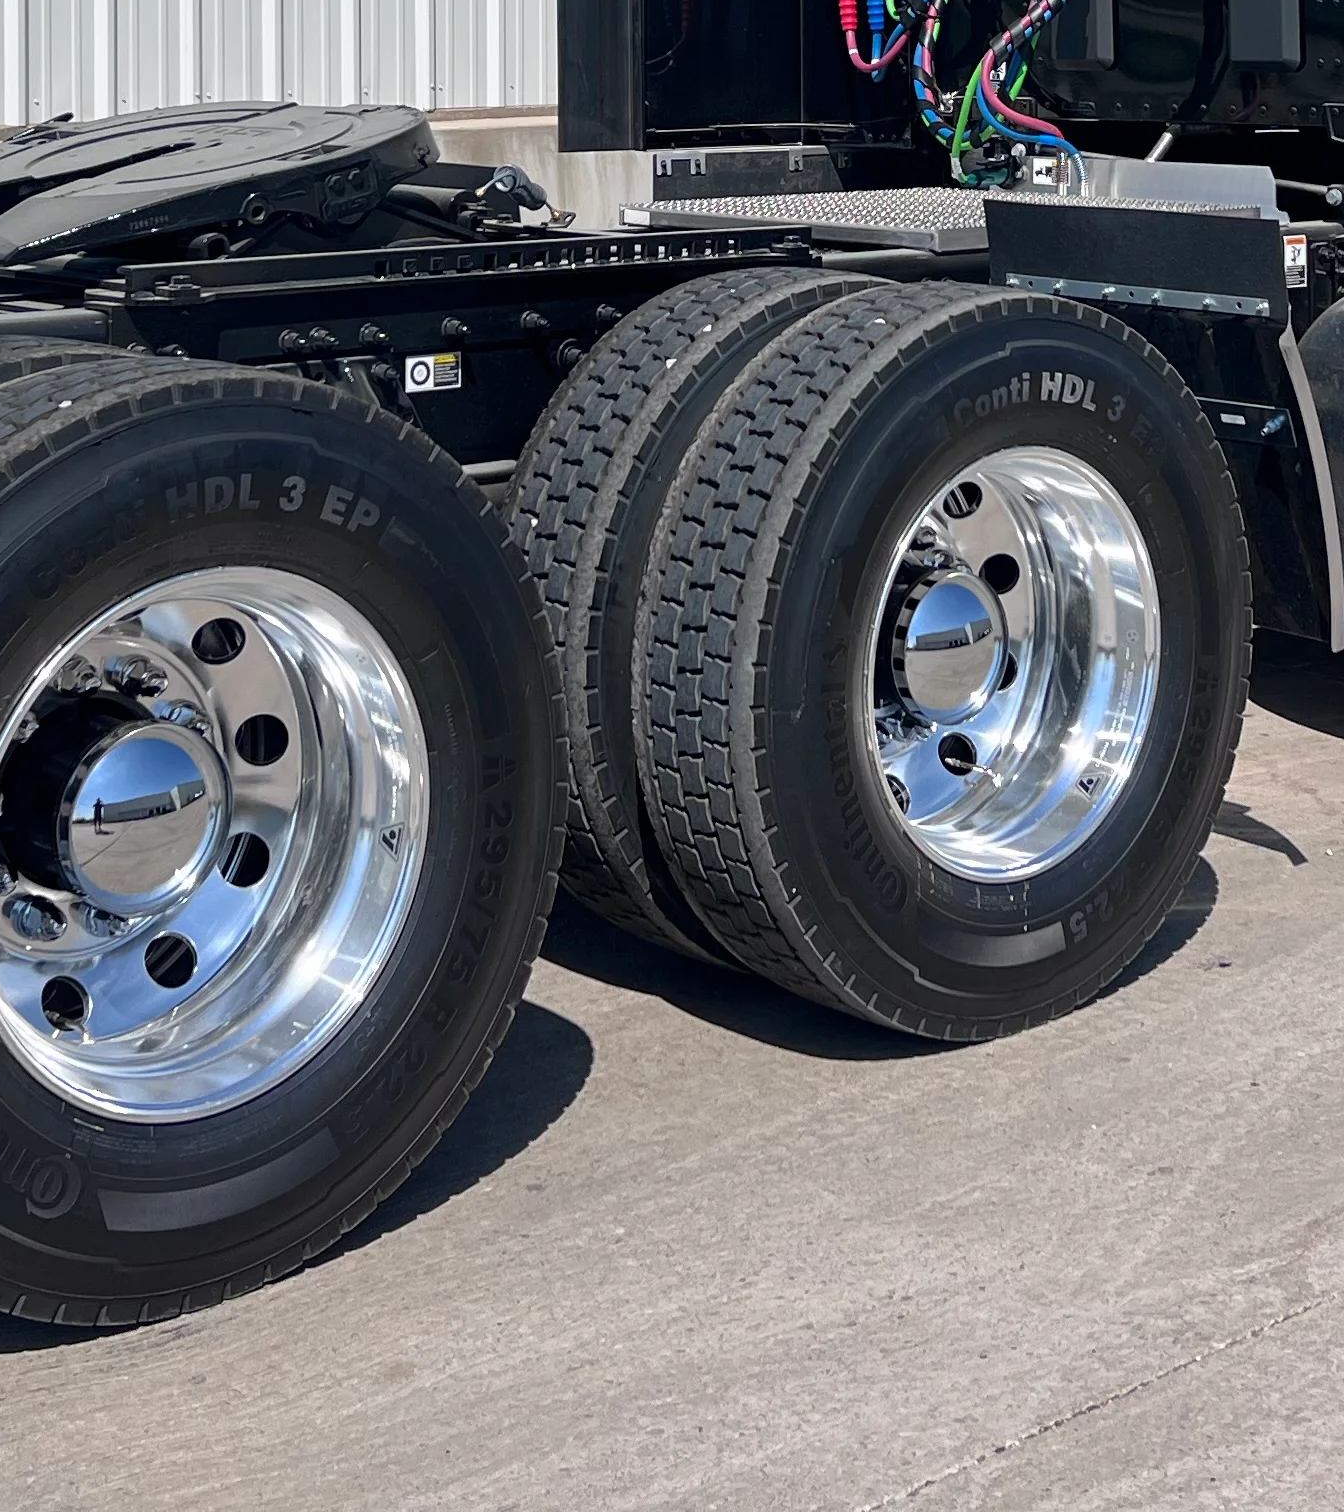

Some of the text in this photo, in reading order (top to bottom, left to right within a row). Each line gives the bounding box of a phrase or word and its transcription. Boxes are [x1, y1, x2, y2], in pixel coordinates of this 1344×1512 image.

[953, 372, 1032, 429] Conti
[1040, 371, 1098, 412] HDL
[1107, 394, 1127, 423] 3
[164, 472, 261, 525] HDL
[278, 474, 307, 513] 3
[318, 484, 382, 533] EP
